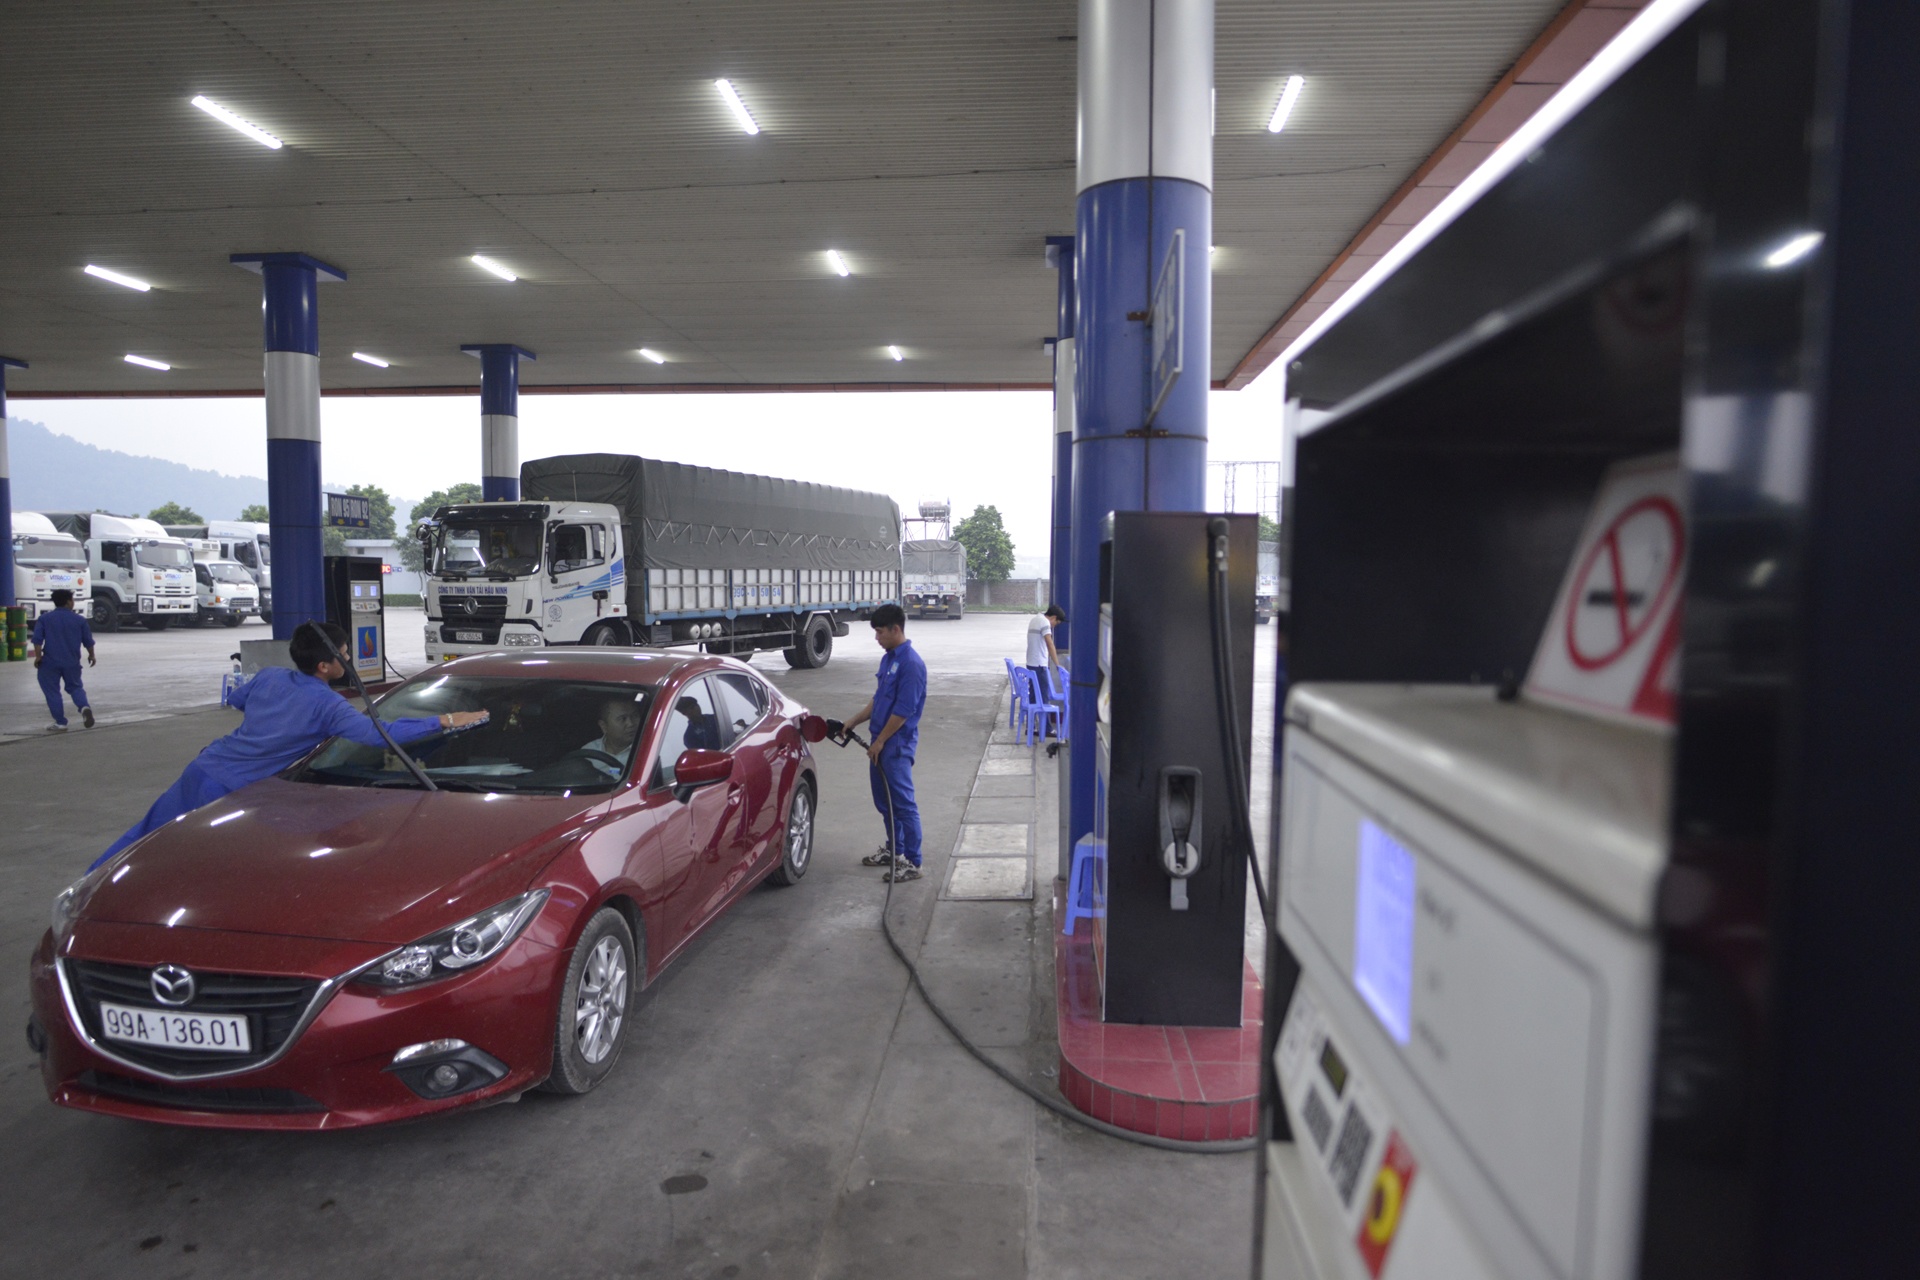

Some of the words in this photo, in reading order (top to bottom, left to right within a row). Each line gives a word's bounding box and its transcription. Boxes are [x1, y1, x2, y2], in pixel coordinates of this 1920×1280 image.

[343, 498, 350, 517] 95
[362, 500, 369, 519] 92
[438, 585, 448, 594] CÔNG
[449, 586, 453, 594] TY
[455, 586, 465, 594] TNHH
